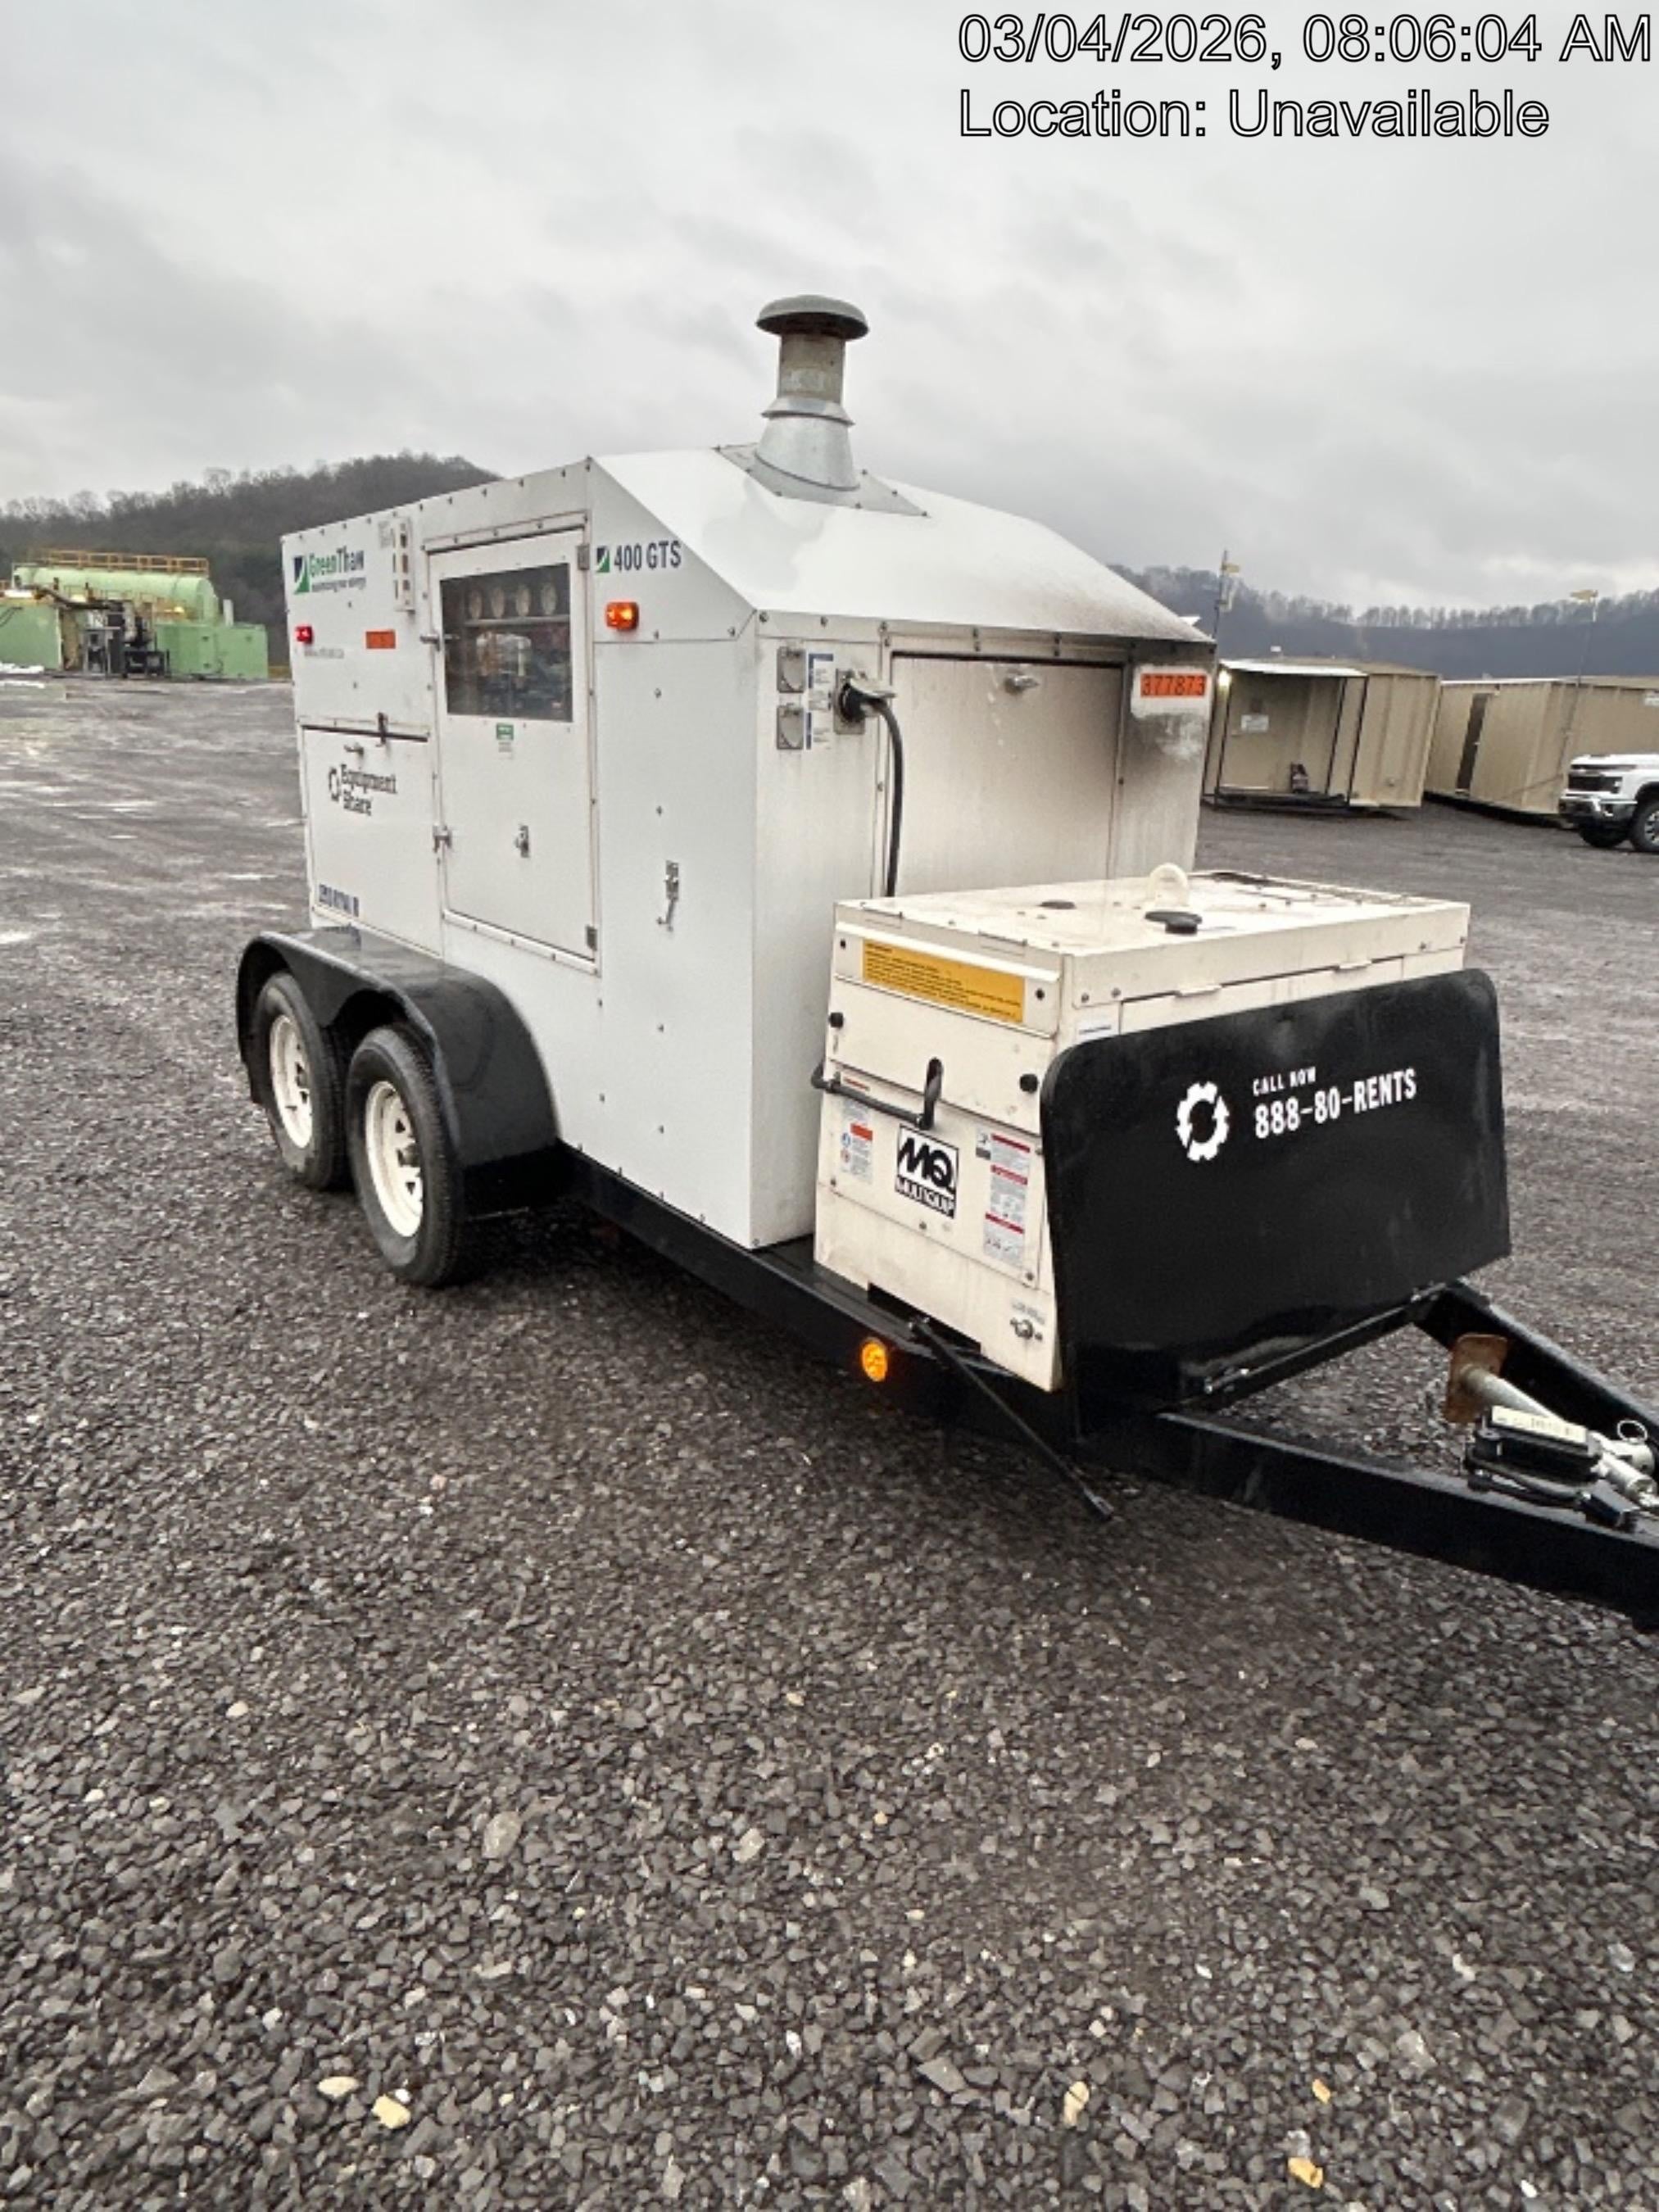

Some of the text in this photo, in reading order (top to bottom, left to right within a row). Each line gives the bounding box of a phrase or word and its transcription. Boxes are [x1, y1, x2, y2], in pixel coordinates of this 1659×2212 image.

[614, 540, 682, 571] 400 GTS
[1141, 674, 1207, 697] 377873
[341, 764, 397, 795] Equipment
[342, 790, 372, 816] Share
[1252, 1066, 1316, 1097] CALL NOW
[1253, 1067, 1417, 1140] 888-80-RENTS
[897, 1136, 957, 1194] MQ
